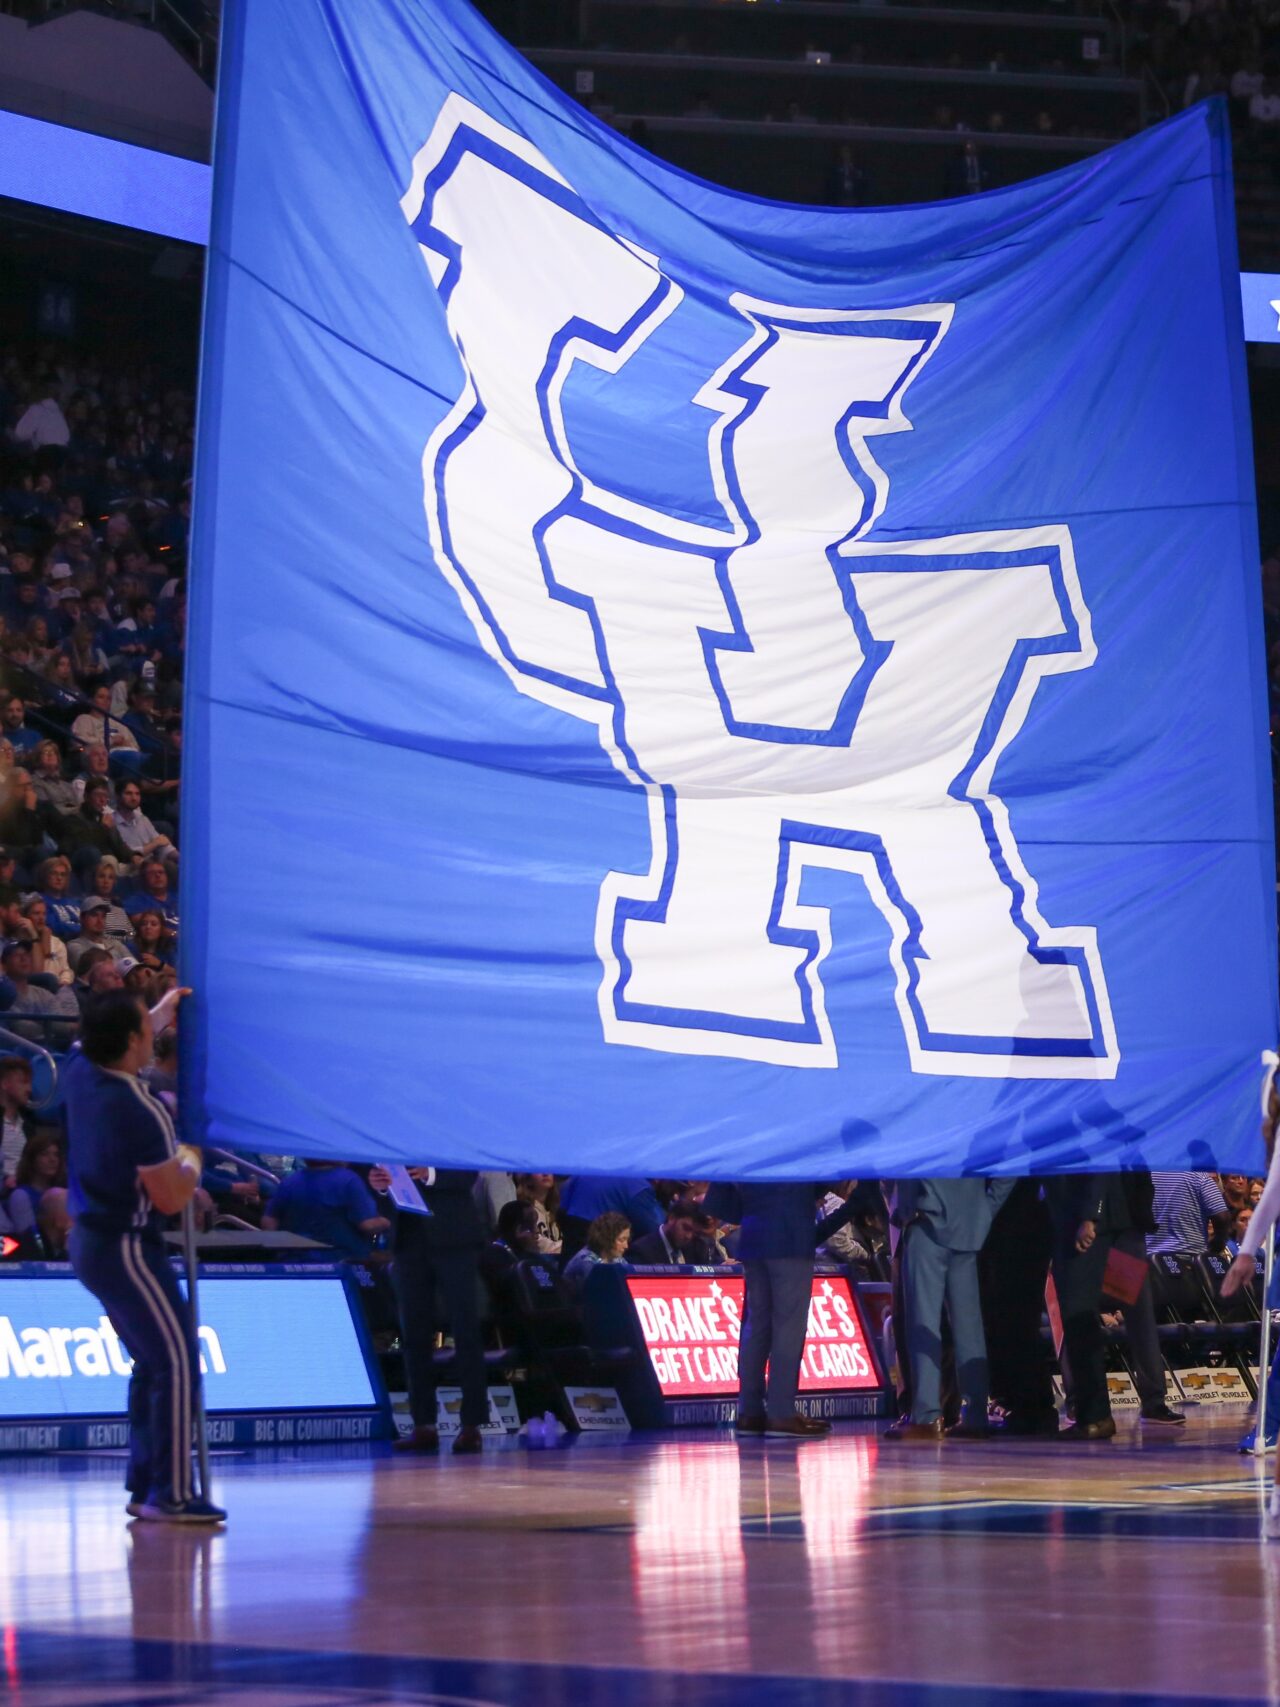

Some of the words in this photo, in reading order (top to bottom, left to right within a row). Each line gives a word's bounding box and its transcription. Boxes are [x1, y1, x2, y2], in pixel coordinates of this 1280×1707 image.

[400, 90, 1121, 1082] UK
[0, 1315, 227, 1378] Maratn
[650, 1347, 695, 1384] GIFT
[807, 1342, 869, 1377] CARDS
[578, 1415, 626, 1425] CHEVROLET
[673, 1404, 718, 1425] KENTUCKY
[810, 1400, 822, 1418] ON
[823, 1397, 879, 1417] COMMITMENT
[87, 1424, 131, 1446] KENTU
[255, 1419, 275, 1442] BIG
[278, 1418, 294, 1441] ON
[296, 1417, 373, 1440] COMMITMENT
